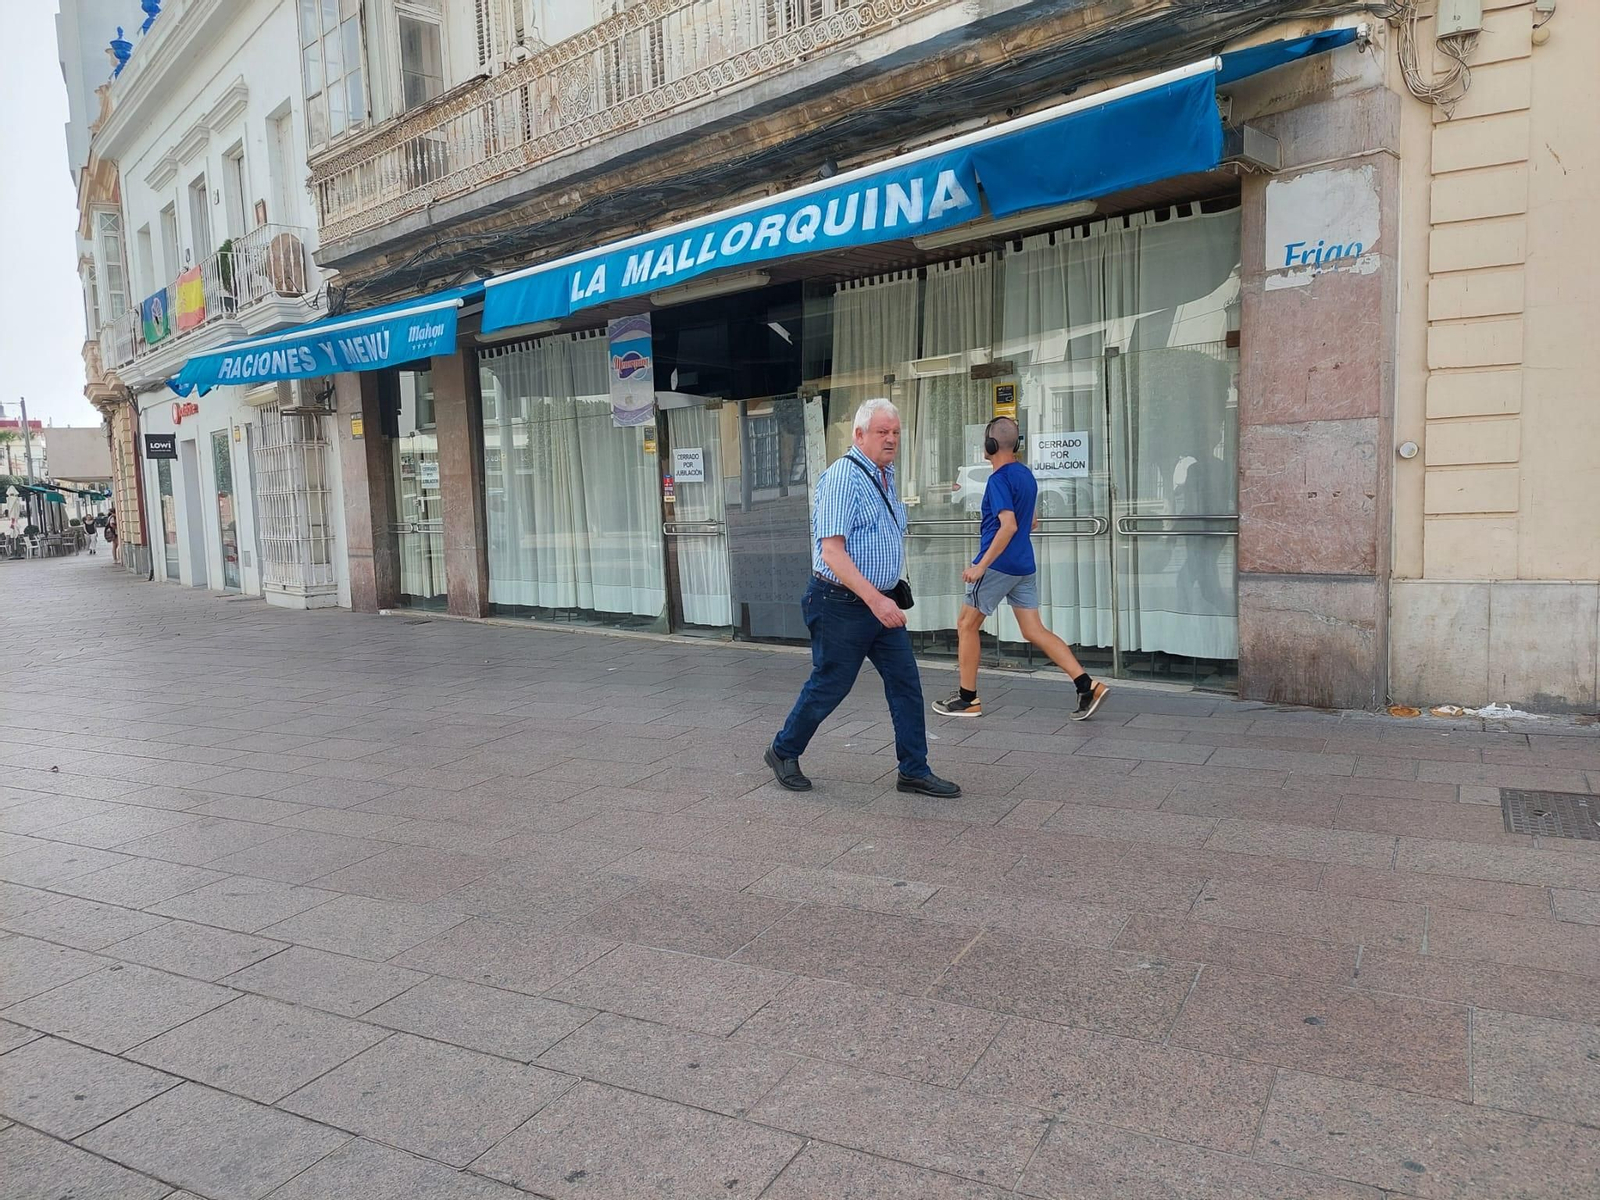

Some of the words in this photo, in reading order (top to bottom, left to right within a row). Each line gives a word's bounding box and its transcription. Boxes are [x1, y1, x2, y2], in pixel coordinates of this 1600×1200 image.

[570, 263, 606, 303] LA
[621, 169, 973, 288] MALLORQUINA
[408, 323, 445, 343] Mahou
[217, 345, 317, 379] RACIONES
[318, 341, 337, 366] Y
[338, 326, 390, 365] MENÚ
[1038, 439, 1082, 449] CERRADO
[1050, 451, 1069, 459] POR
[1034, 459, 1086, 471] JUBILACIÓN
